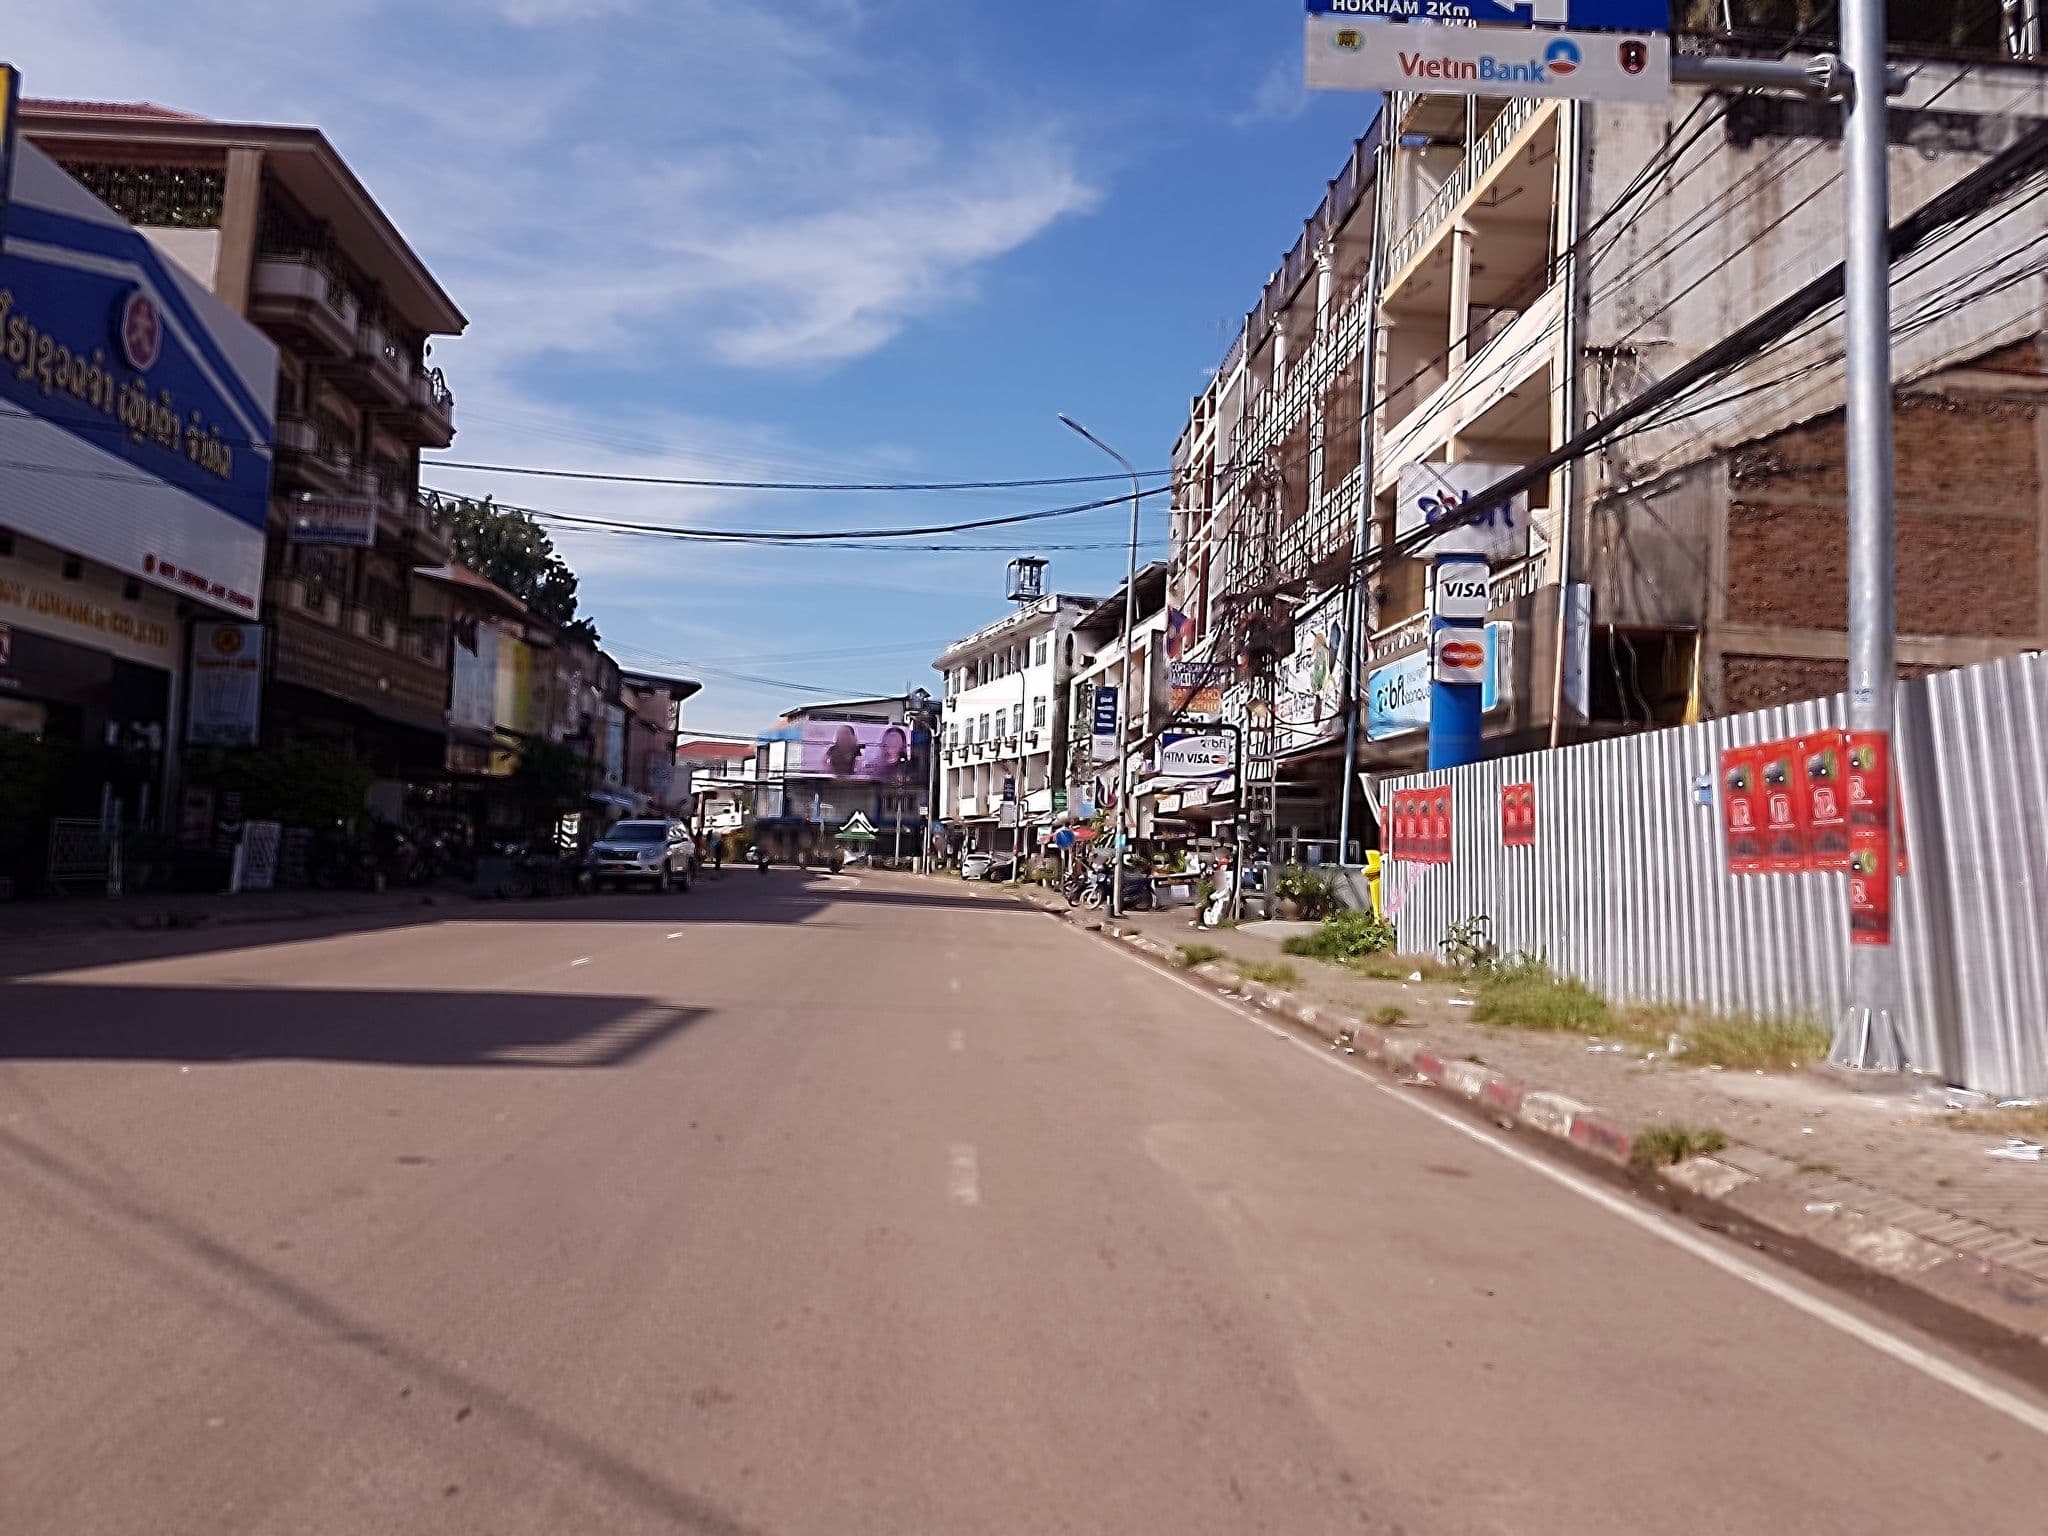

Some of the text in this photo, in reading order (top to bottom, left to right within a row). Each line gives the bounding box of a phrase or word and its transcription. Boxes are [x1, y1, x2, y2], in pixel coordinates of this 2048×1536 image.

[1426, 1, 1470, 17] 2Km
[1398, 51, 1546, 84] VietinBank
[1444, 582, 1487, 598] VISA
[1165, 751, 1210, 764] ATM VISA
